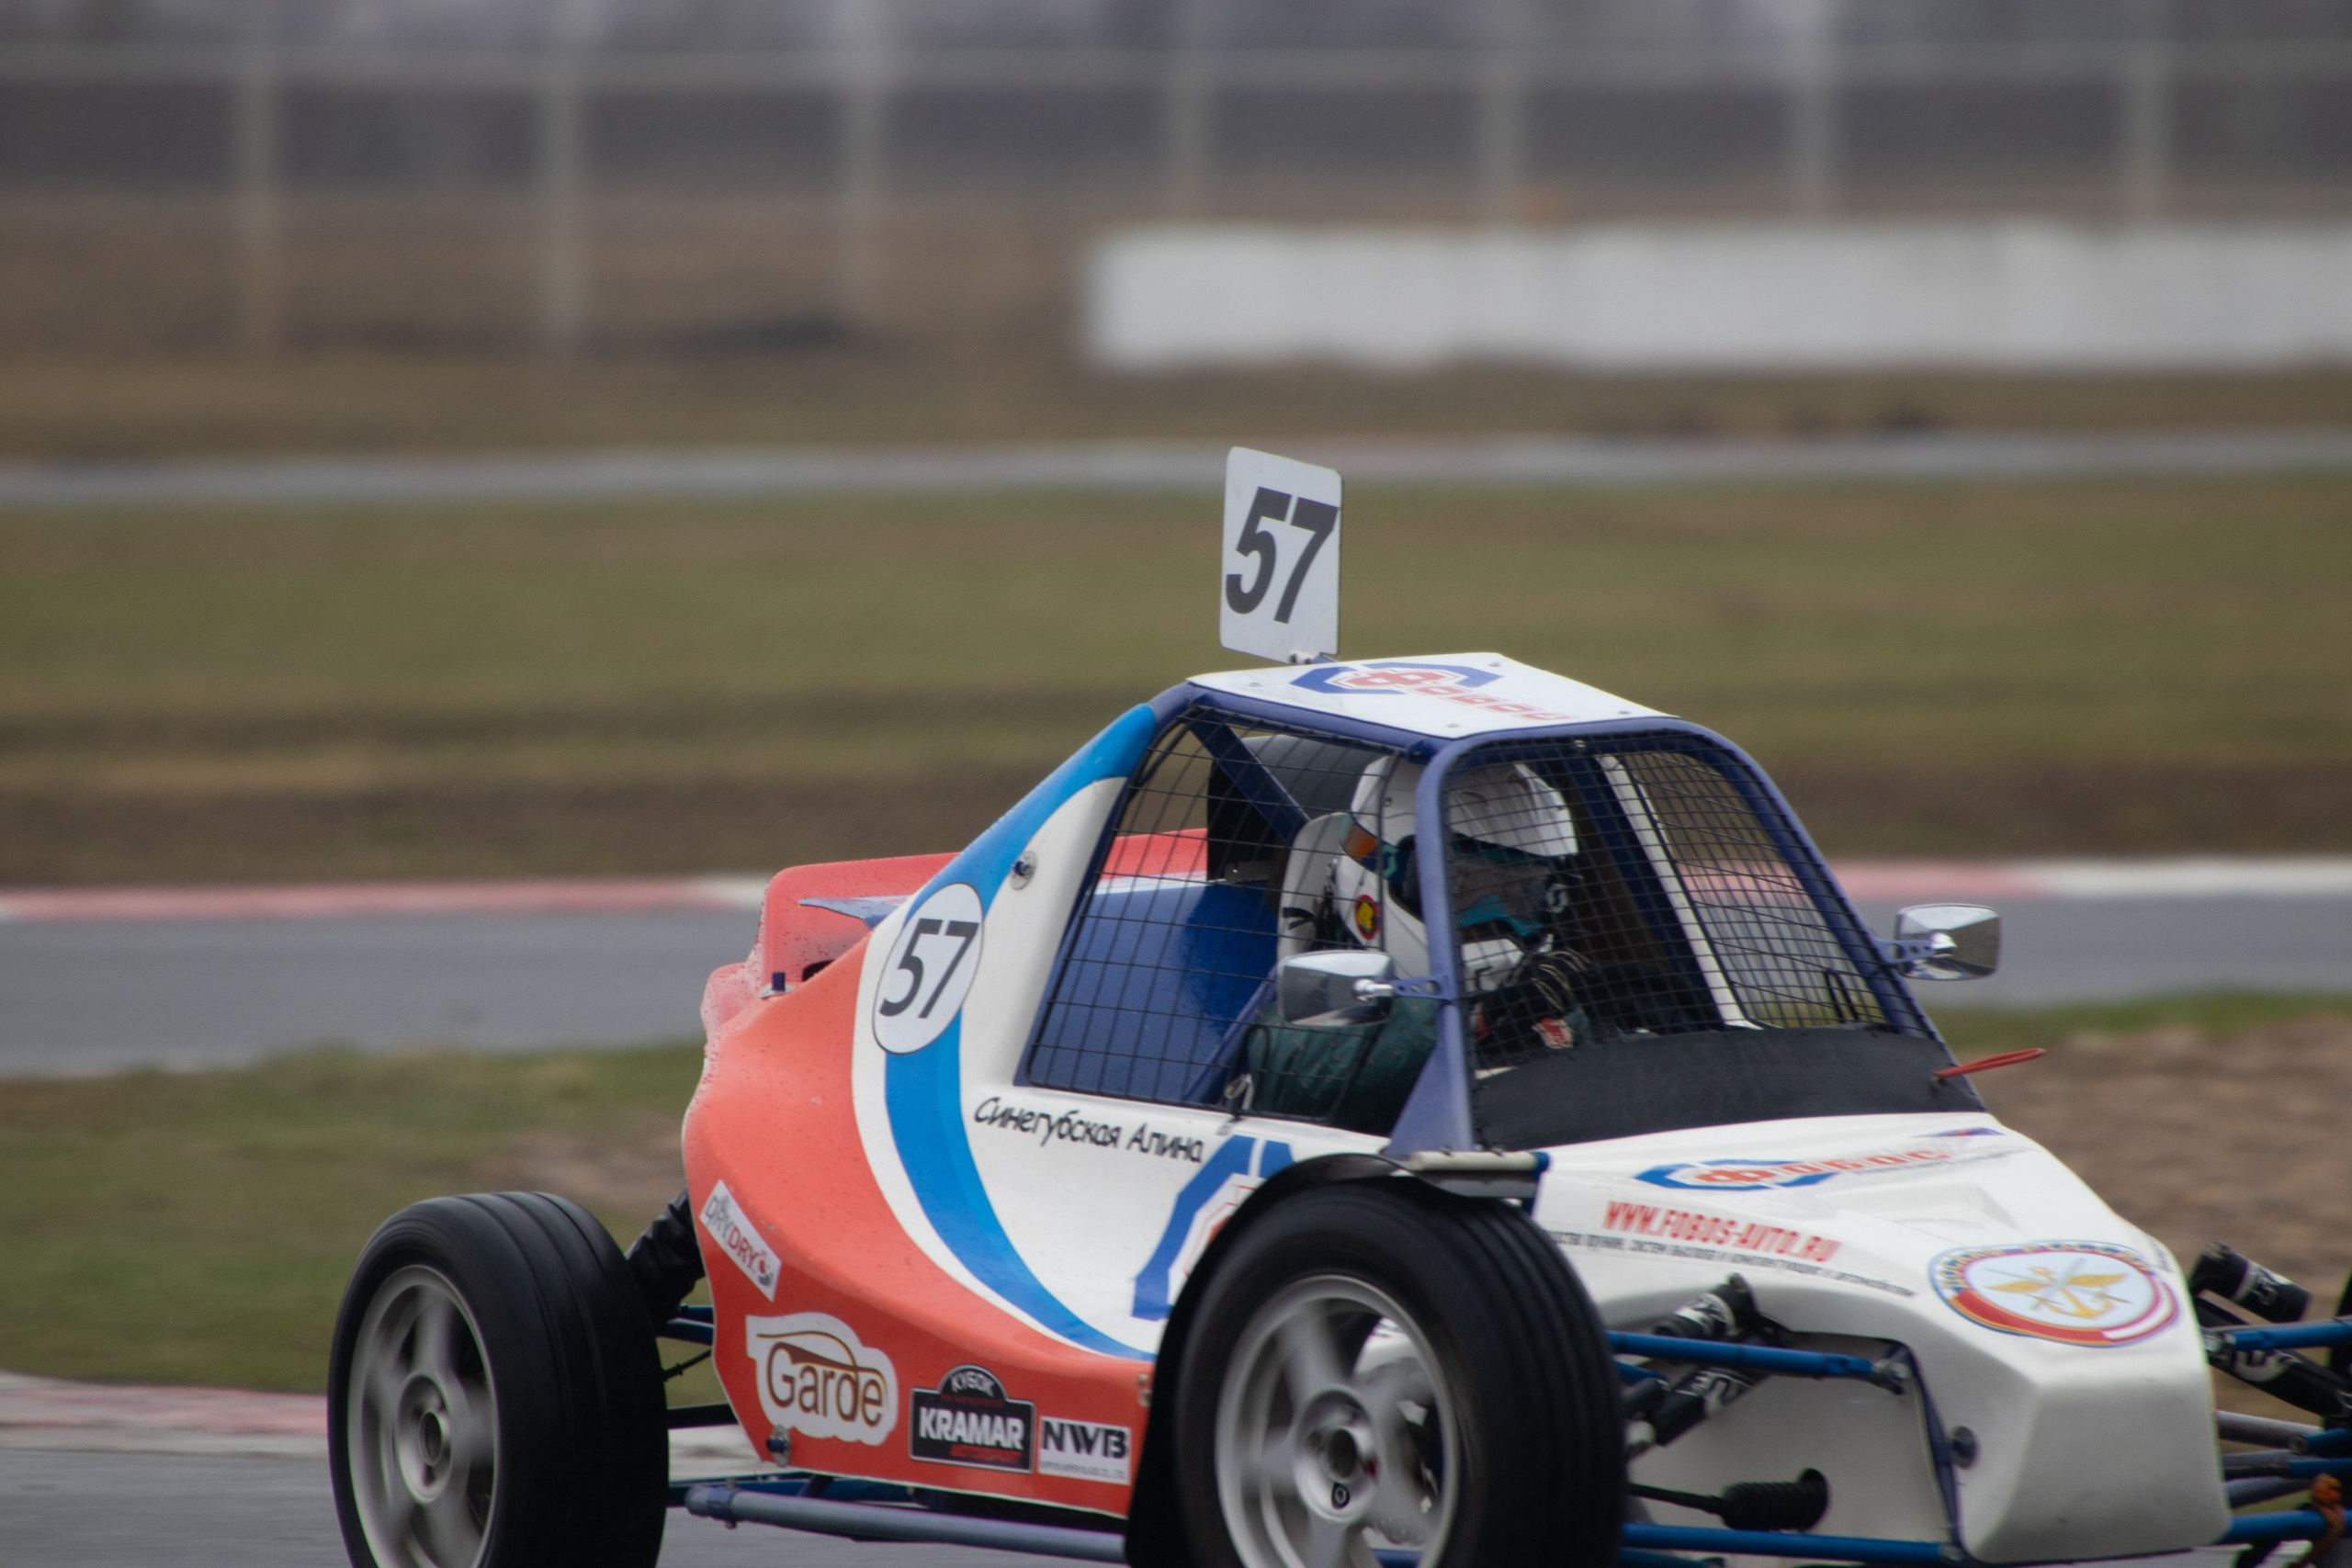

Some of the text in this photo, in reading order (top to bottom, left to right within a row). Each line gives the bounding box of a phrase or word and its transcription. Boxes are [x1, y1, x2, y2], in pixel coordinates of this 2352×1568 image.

[1226, 485, 1340, 625] 57
[878, 918, 979, 1020] 57
[973, 1096, 1205, 1164] Синегубская Алина
[765, 1342, 887, 1428] Garde
[919, 1405, 1024, 1451] KRAMAR
[1041, 1420, 1127, 1459] NWB
